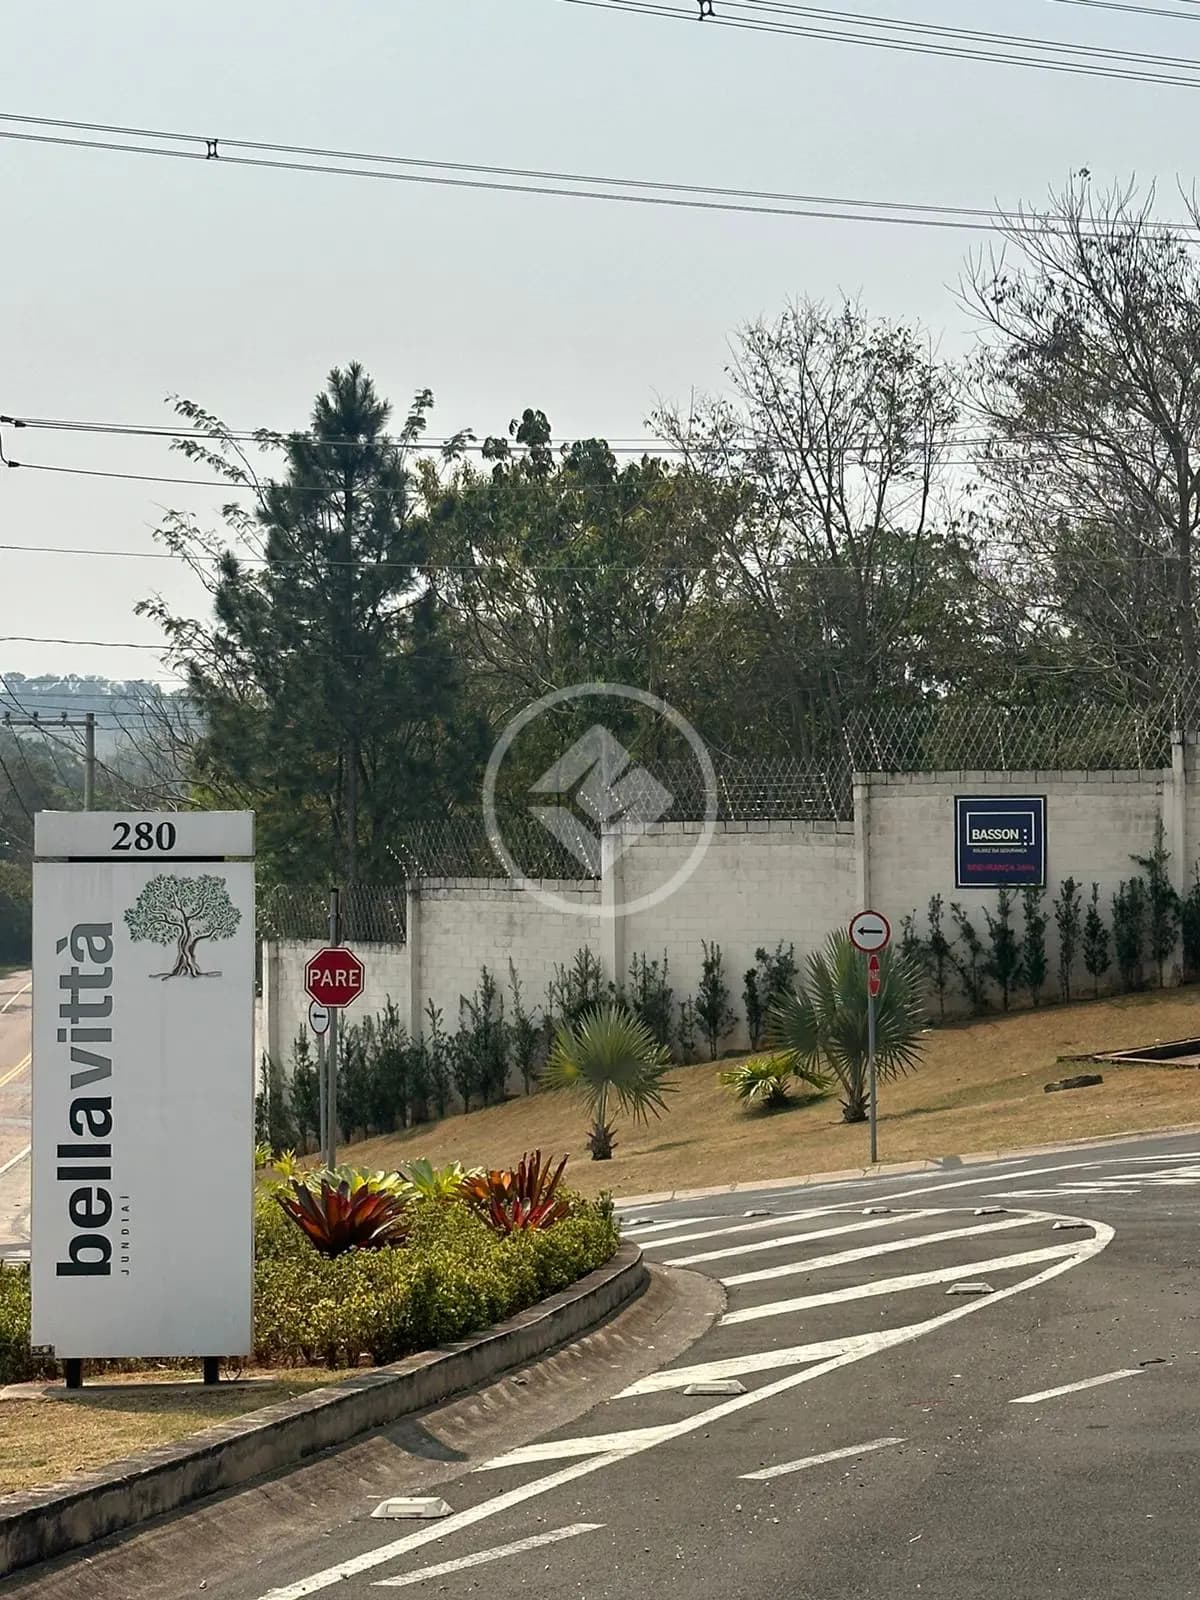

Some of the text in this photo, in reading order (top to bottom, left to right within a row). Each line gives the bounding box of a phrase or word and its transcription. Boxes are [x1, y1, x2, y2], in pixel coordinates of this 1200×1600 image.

[111, 821, 177, 851] 280
[972, 829, 1019, 840] BASSON
[309, 969, 360, 987] PARE
